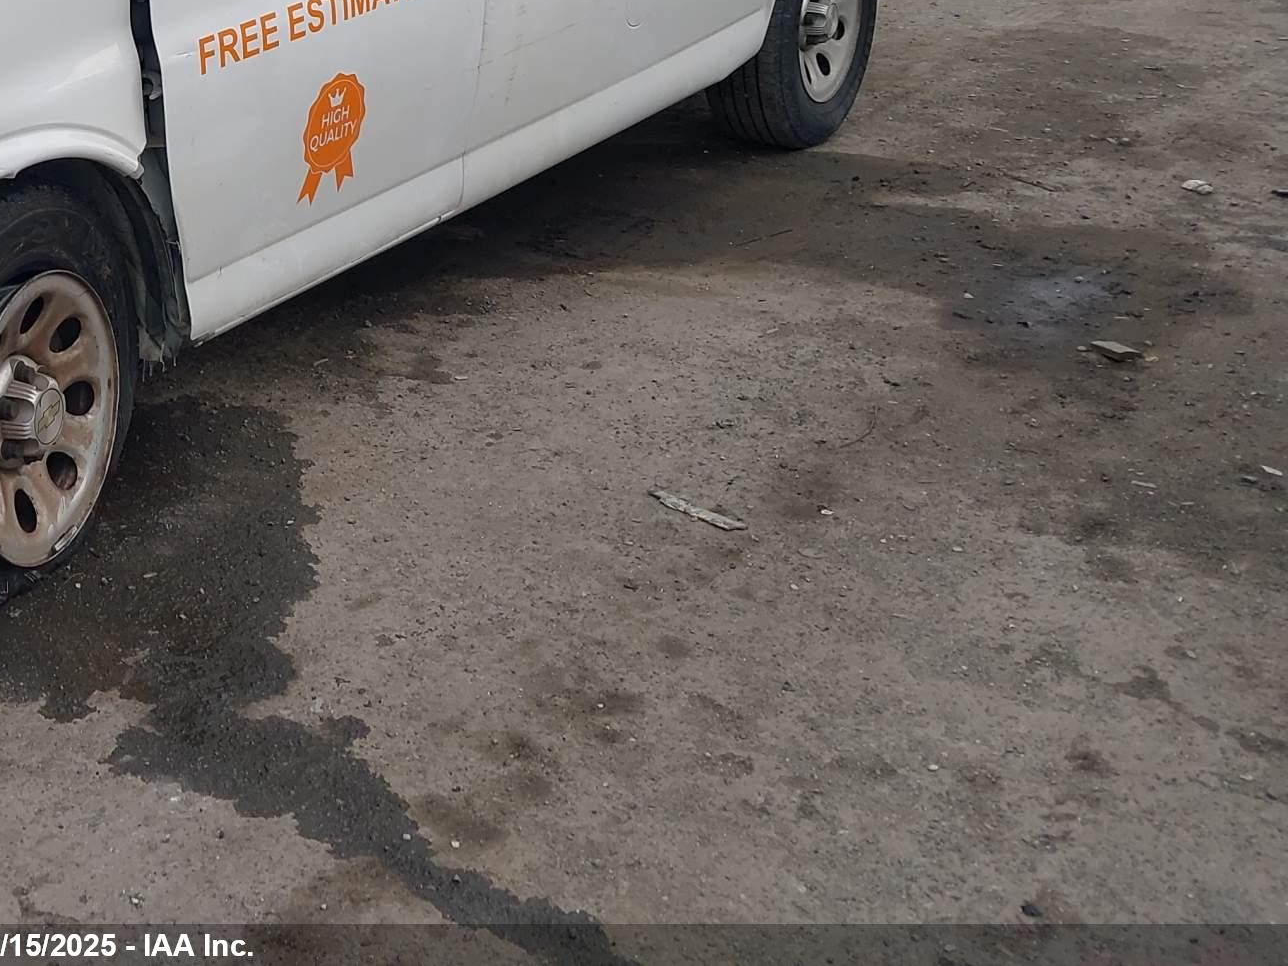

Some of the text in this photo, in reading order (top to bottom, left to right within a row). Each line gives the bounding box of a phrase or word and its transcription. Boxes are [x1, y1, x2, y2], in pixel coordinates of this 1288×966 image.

[197, 11, 281, 76] FREE
[320, 105, 351, 129] HIGH
[309, 119, 358, 152] QUALITY
